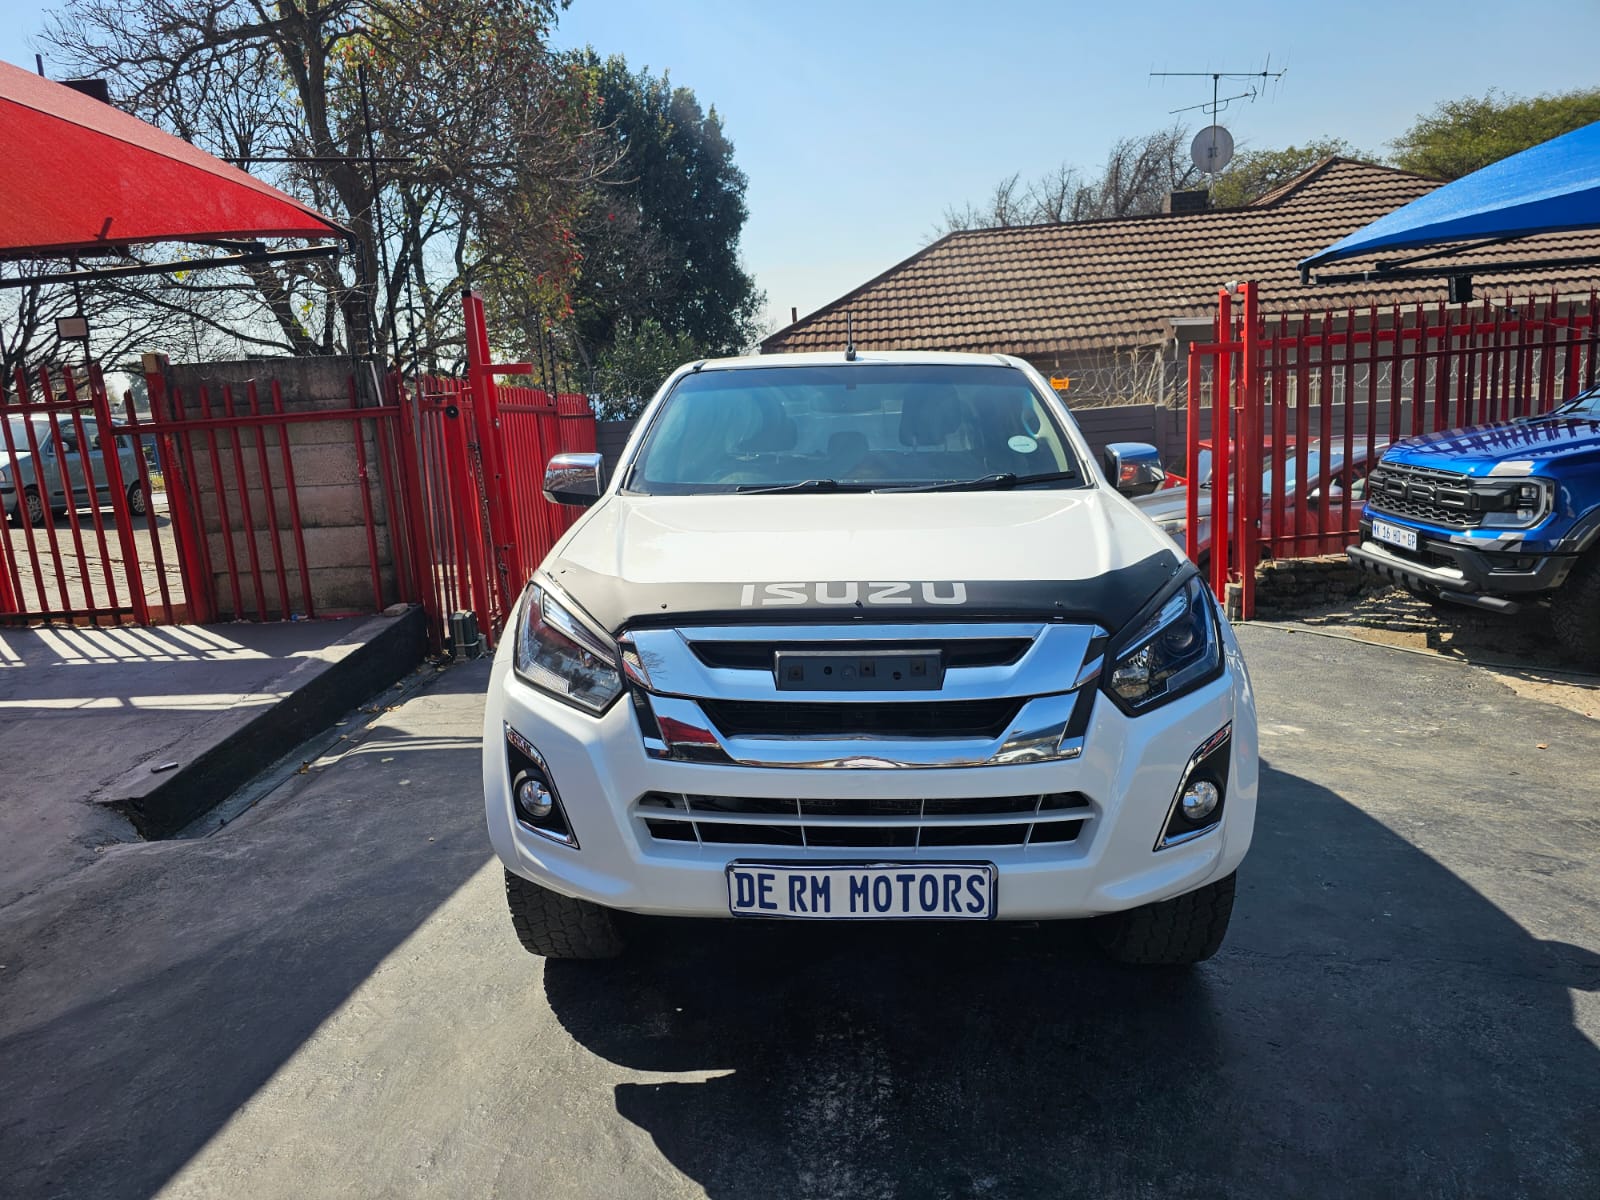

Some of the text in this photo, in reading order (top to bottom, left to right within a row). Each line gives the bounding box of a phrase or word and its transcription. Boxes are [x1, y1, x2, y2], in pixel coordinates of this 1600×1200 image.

[1407, 532, 1416, 548] GP
[740, 581, 967, 607] ISUZU
[735, 872, 986, 914] DE RM MOTORS
